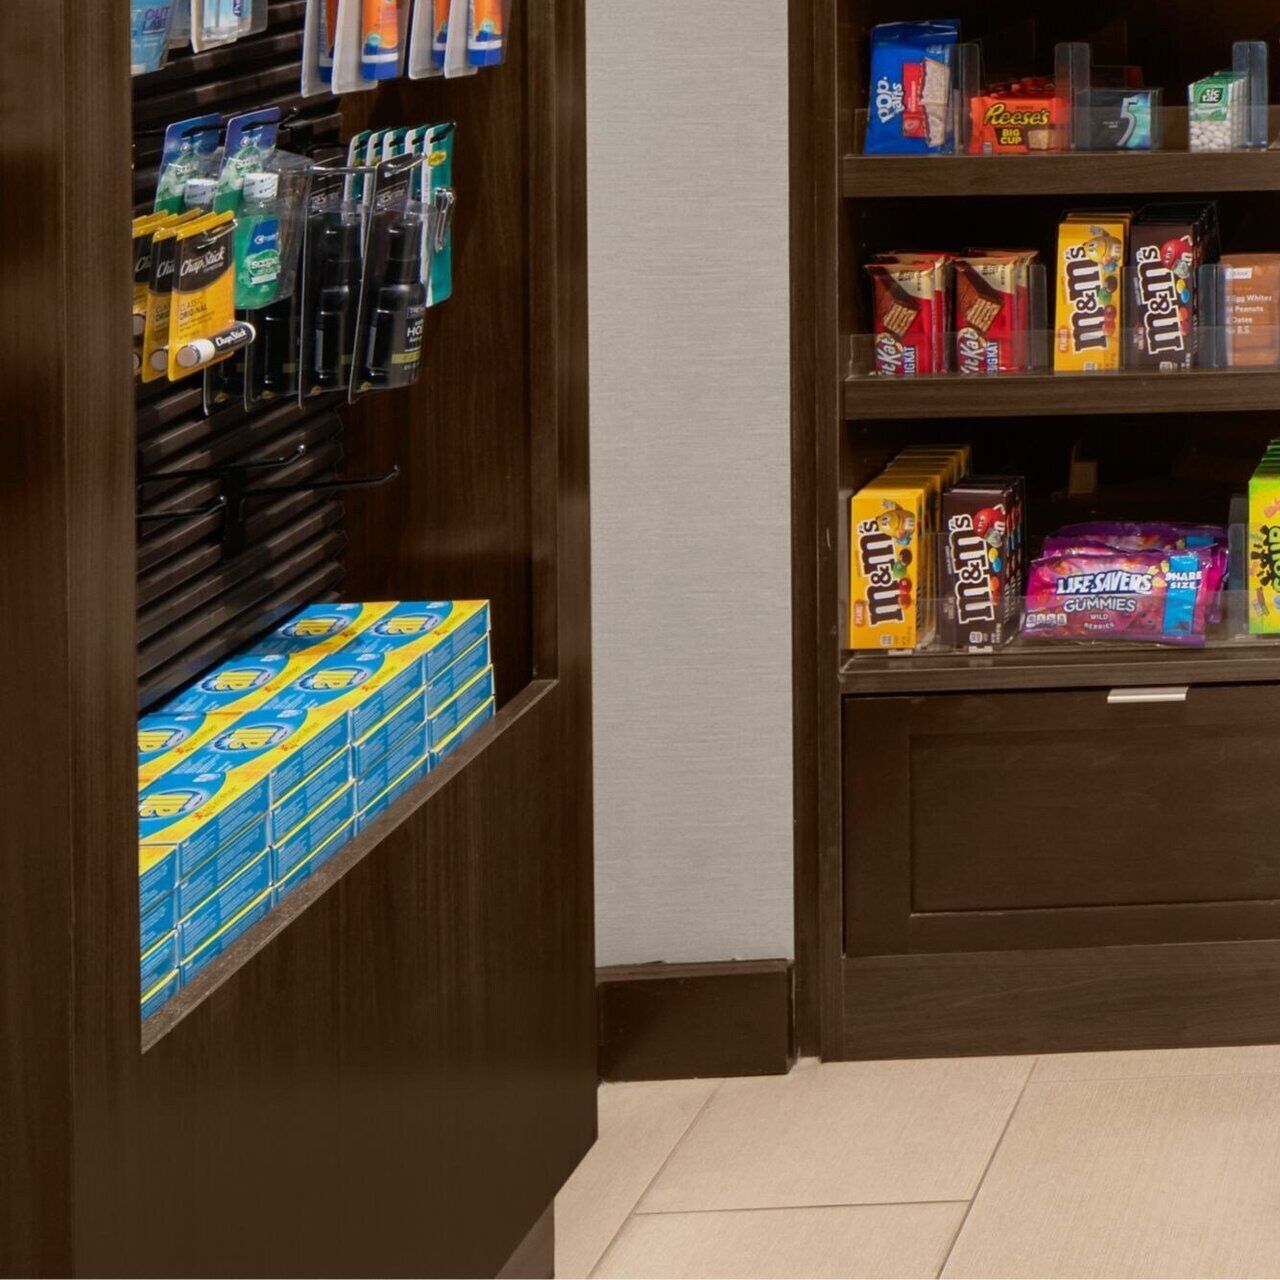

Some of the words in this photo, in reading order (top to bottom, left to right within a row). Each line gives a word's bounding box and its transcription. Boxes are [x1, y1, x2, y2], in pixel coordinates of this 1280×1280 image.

[985, 102, 1049, 126] Reese's
[1117, 97, 1138, 147] 5
[1002, 128, 1020, 137] BIG
[1000, 136, 1022, 145] CUP
[1166, 572, 1201, 581] SHARE
[1063, 598, 1136, 612] GUMMIES
